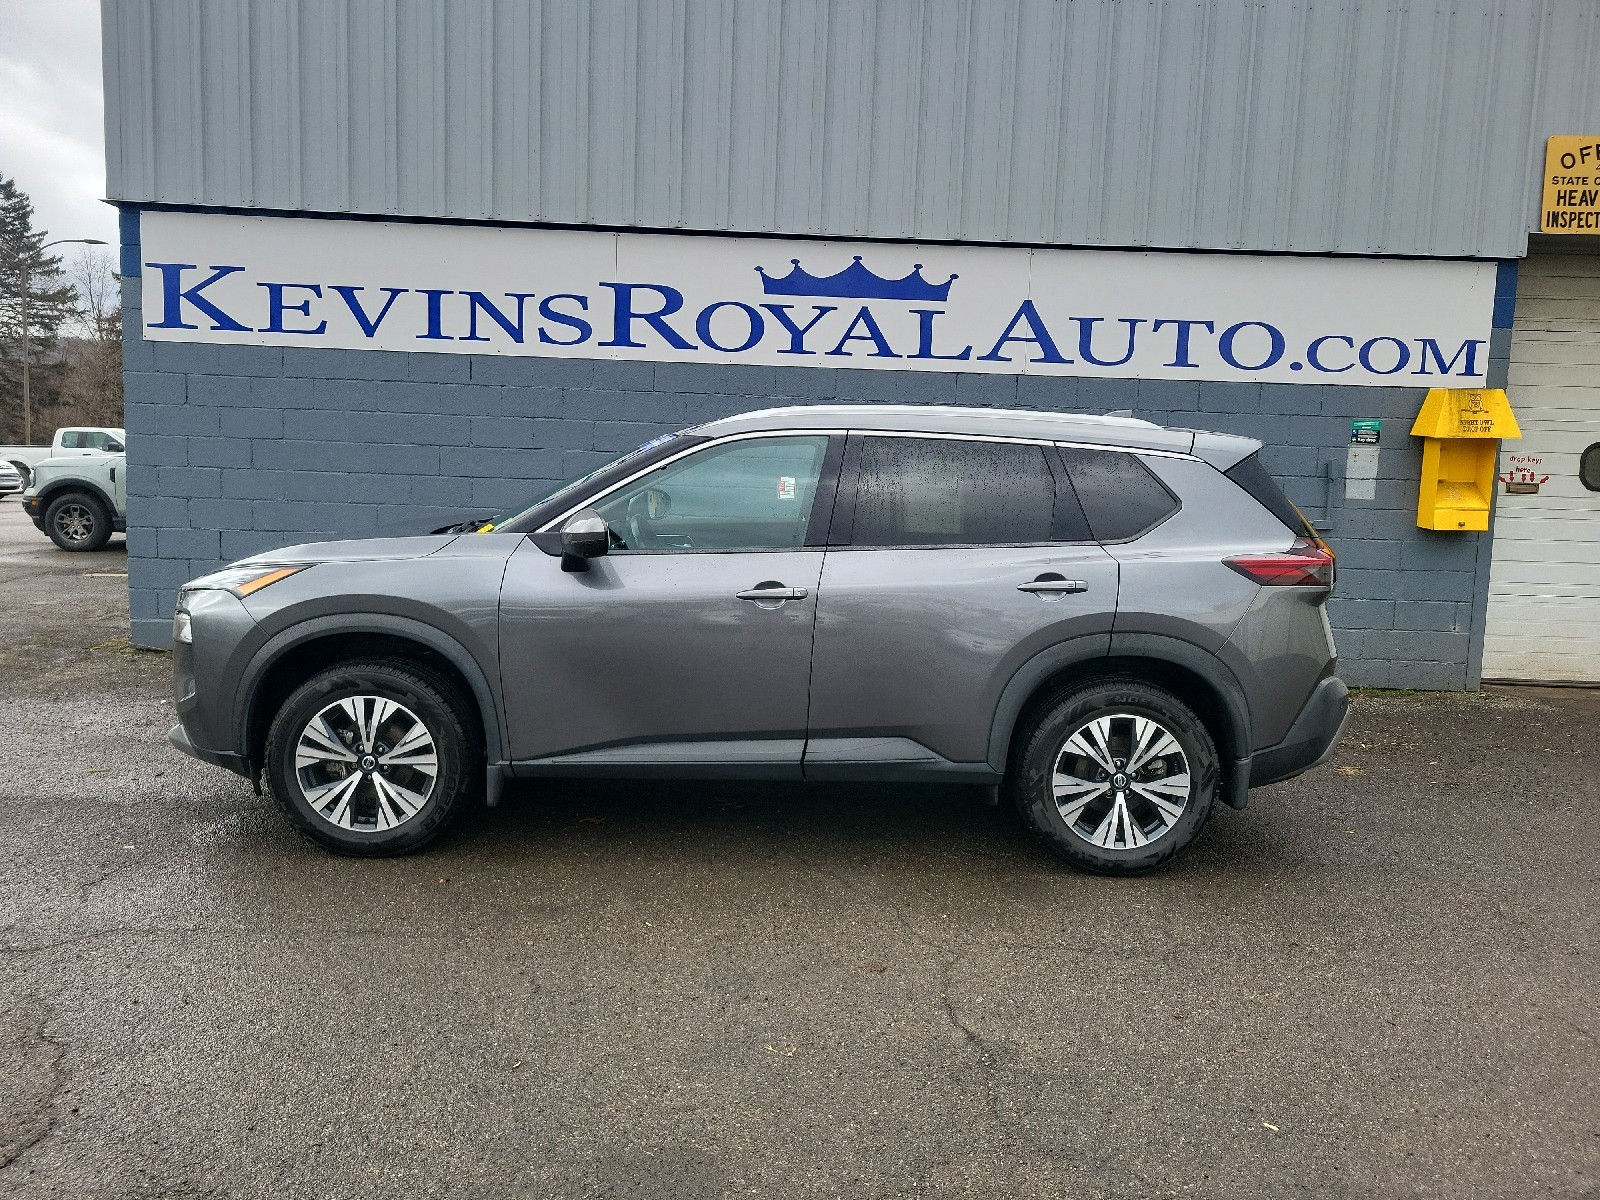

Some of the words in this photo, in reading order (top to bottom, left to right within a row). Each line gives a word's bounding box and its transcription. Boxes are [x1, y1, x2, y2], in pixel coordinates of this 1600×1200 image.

[1552, 176, 1589, 186] STATE
[1556, 189, 1599, 207] HEAV
[1546, 210, 1600, 229] INSPECT
[1510, 455, 1525, 463] drop
[1527, 456, 1542, 464] keys
